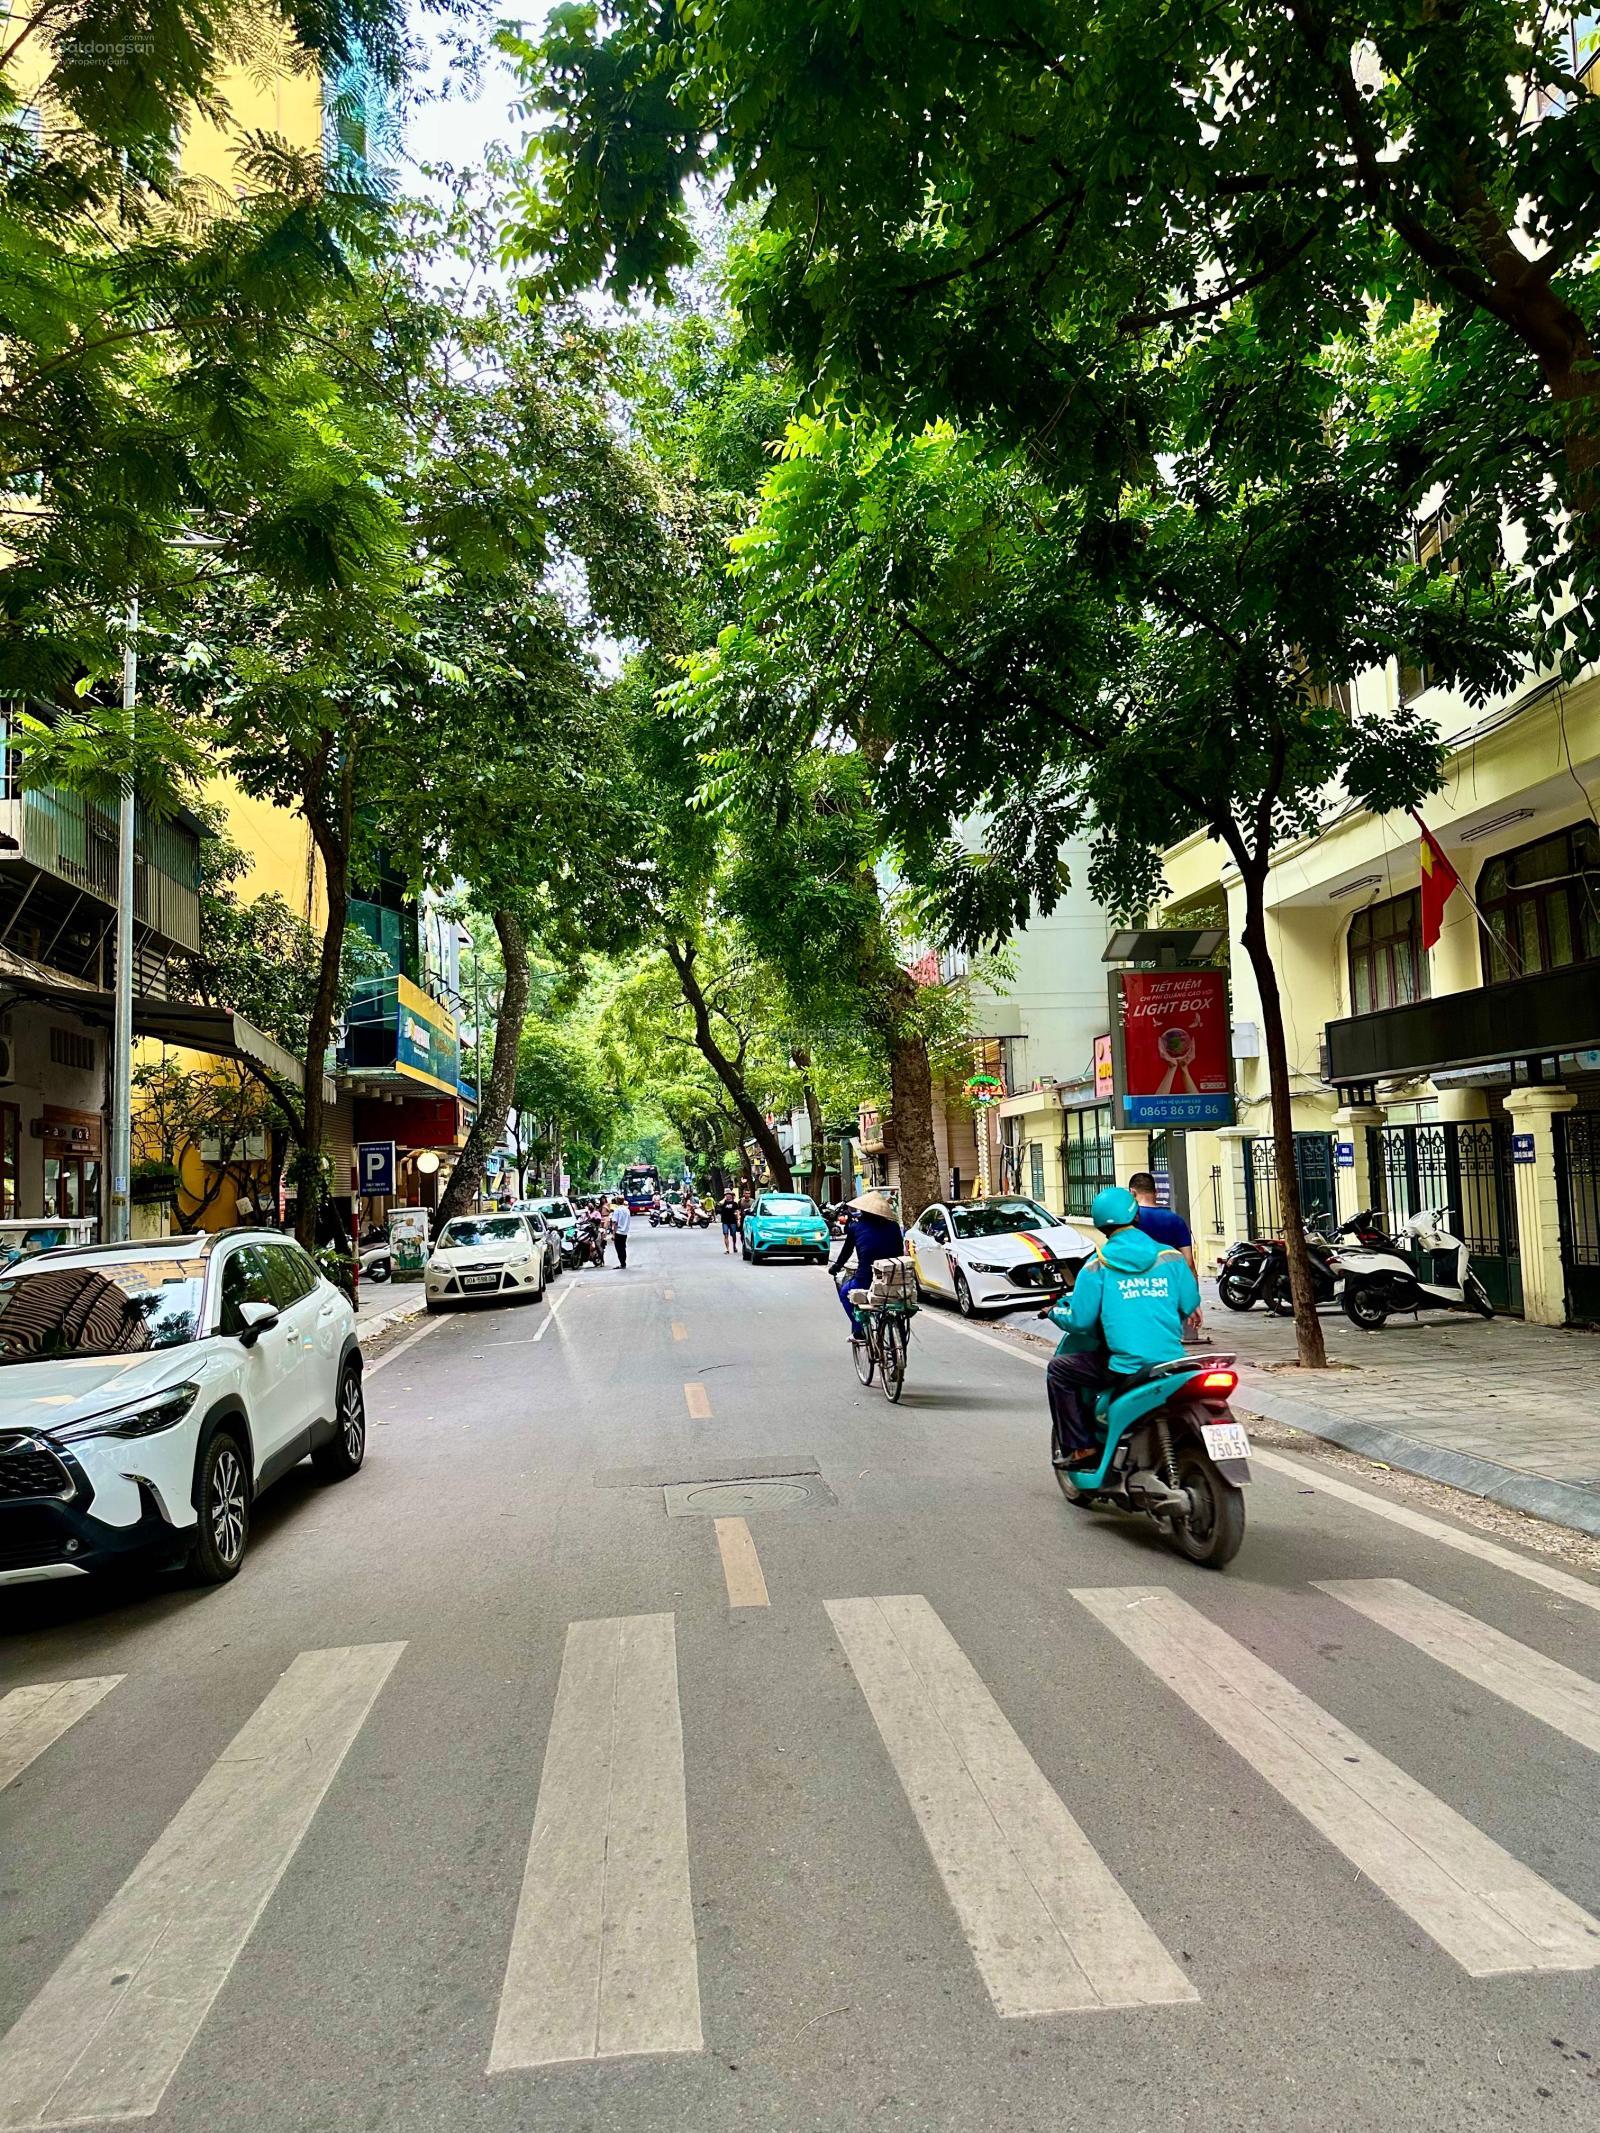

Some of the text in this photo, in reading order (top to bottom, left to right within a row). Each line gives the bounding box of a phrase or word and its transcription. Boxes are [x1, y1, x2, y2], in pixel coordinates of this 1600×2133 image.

[1150, 978, 1202, 992] TIẾT KIỆM
[1133, 997, 1214, 1017] LIGHT BOX
[1140, 1106, 1168, 1117] 0865
[1170, 1105, 1185, 1115] 86
[1187, 1105, 1201, 1115] 87
[1205, 1104, 1219, 1114] 86
[367, 1153, 385, 1180] P
[1117, 1277, 1169, 1290] XANH SM
[1121, 1289, 1141, 1300] xin
[1209, 1441, 1249, 1459] 750.51
